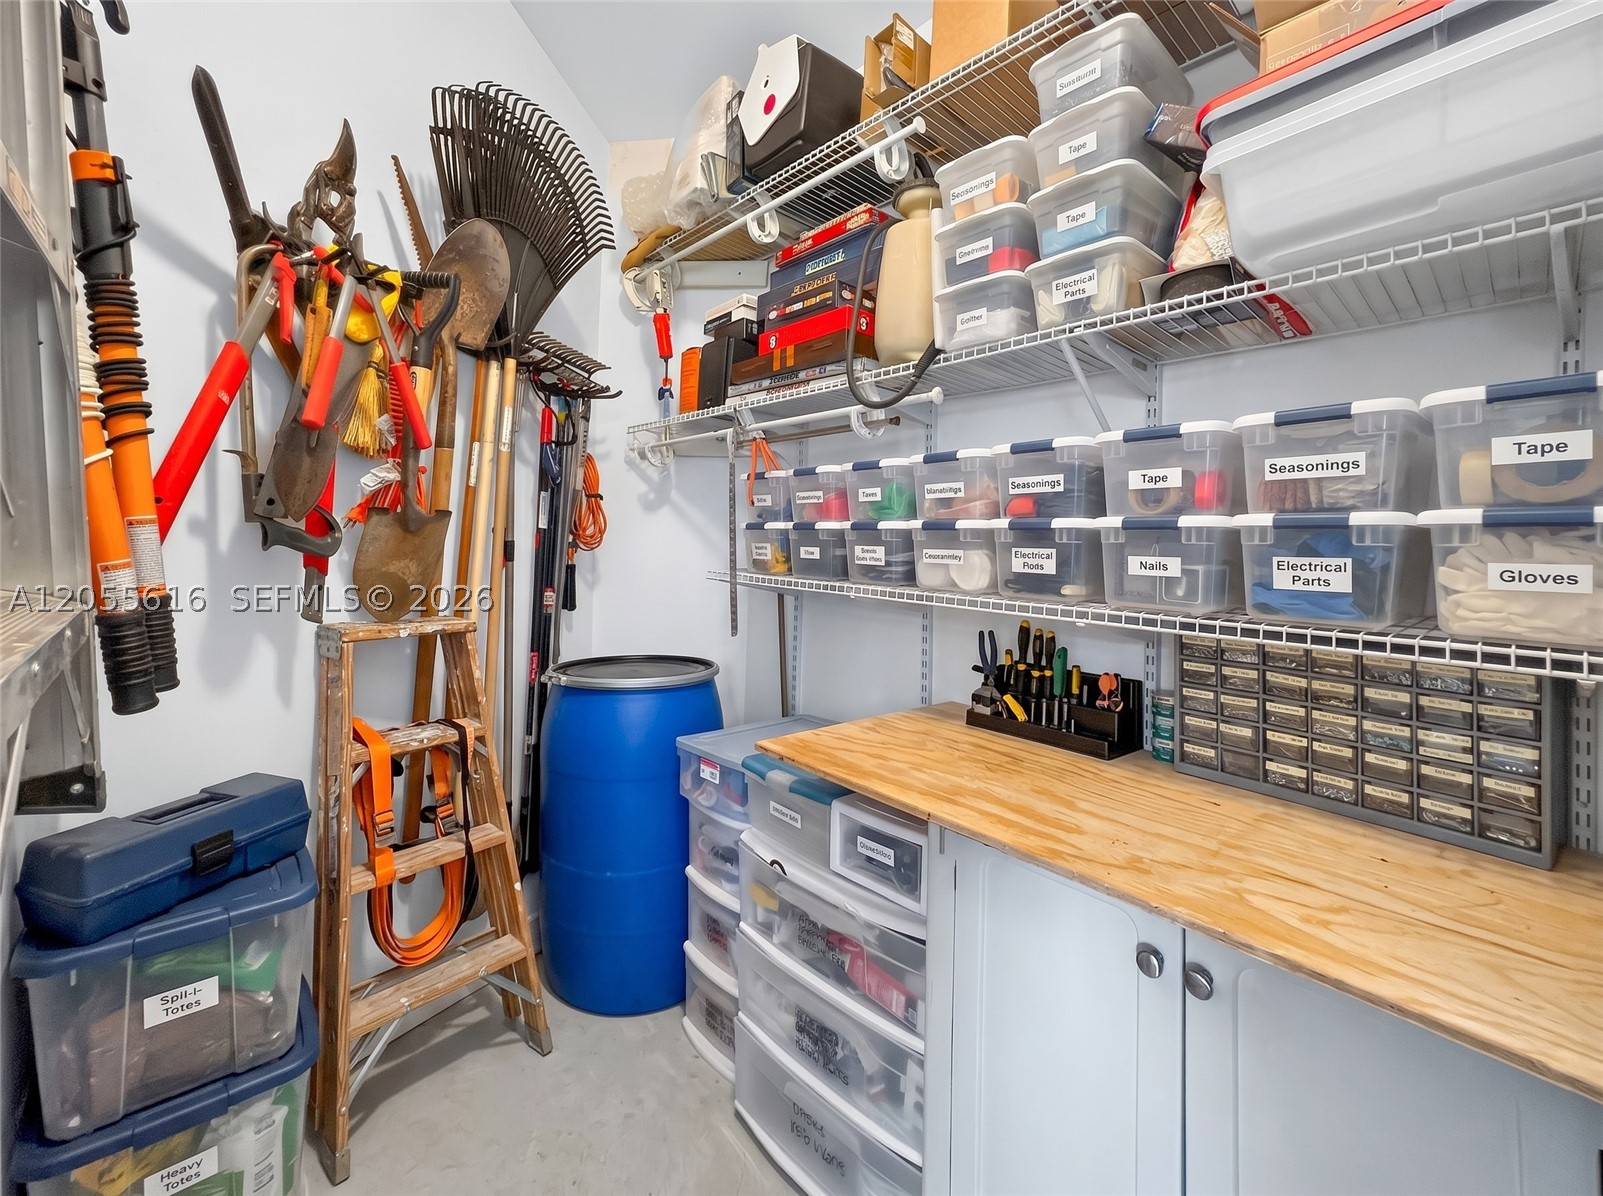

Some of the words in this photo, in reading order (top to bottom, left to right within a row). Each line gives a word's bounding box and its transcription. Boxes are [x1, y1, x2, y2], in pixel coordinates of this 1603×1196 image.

[1068, 142, 1087, 155] Tape
[1066, 210, 1086, 224] Tape
[1064, 286, 1086, 299] Parts
[1512, 440, 1568, 457] Tape
[1268, 459, 1360, 474] Seasonings
[1010, 478, 1061, 489] Seasonings
[1141, 474, 1168, 486] Tape
[1014, 550, 1053, 560] Electrical
[1139, 561, 1169, 572] Nails
[1276, 560, 1347, 574] Electrical
[1291, 575, 1331, 588] Parts
[1499, 570, 1579, 586] Gloves
[162, 1000, 201, 1016] Totes
[160, 1158, 203, 1183] Heavy
[163, 1171, 201, 1192] Totes
